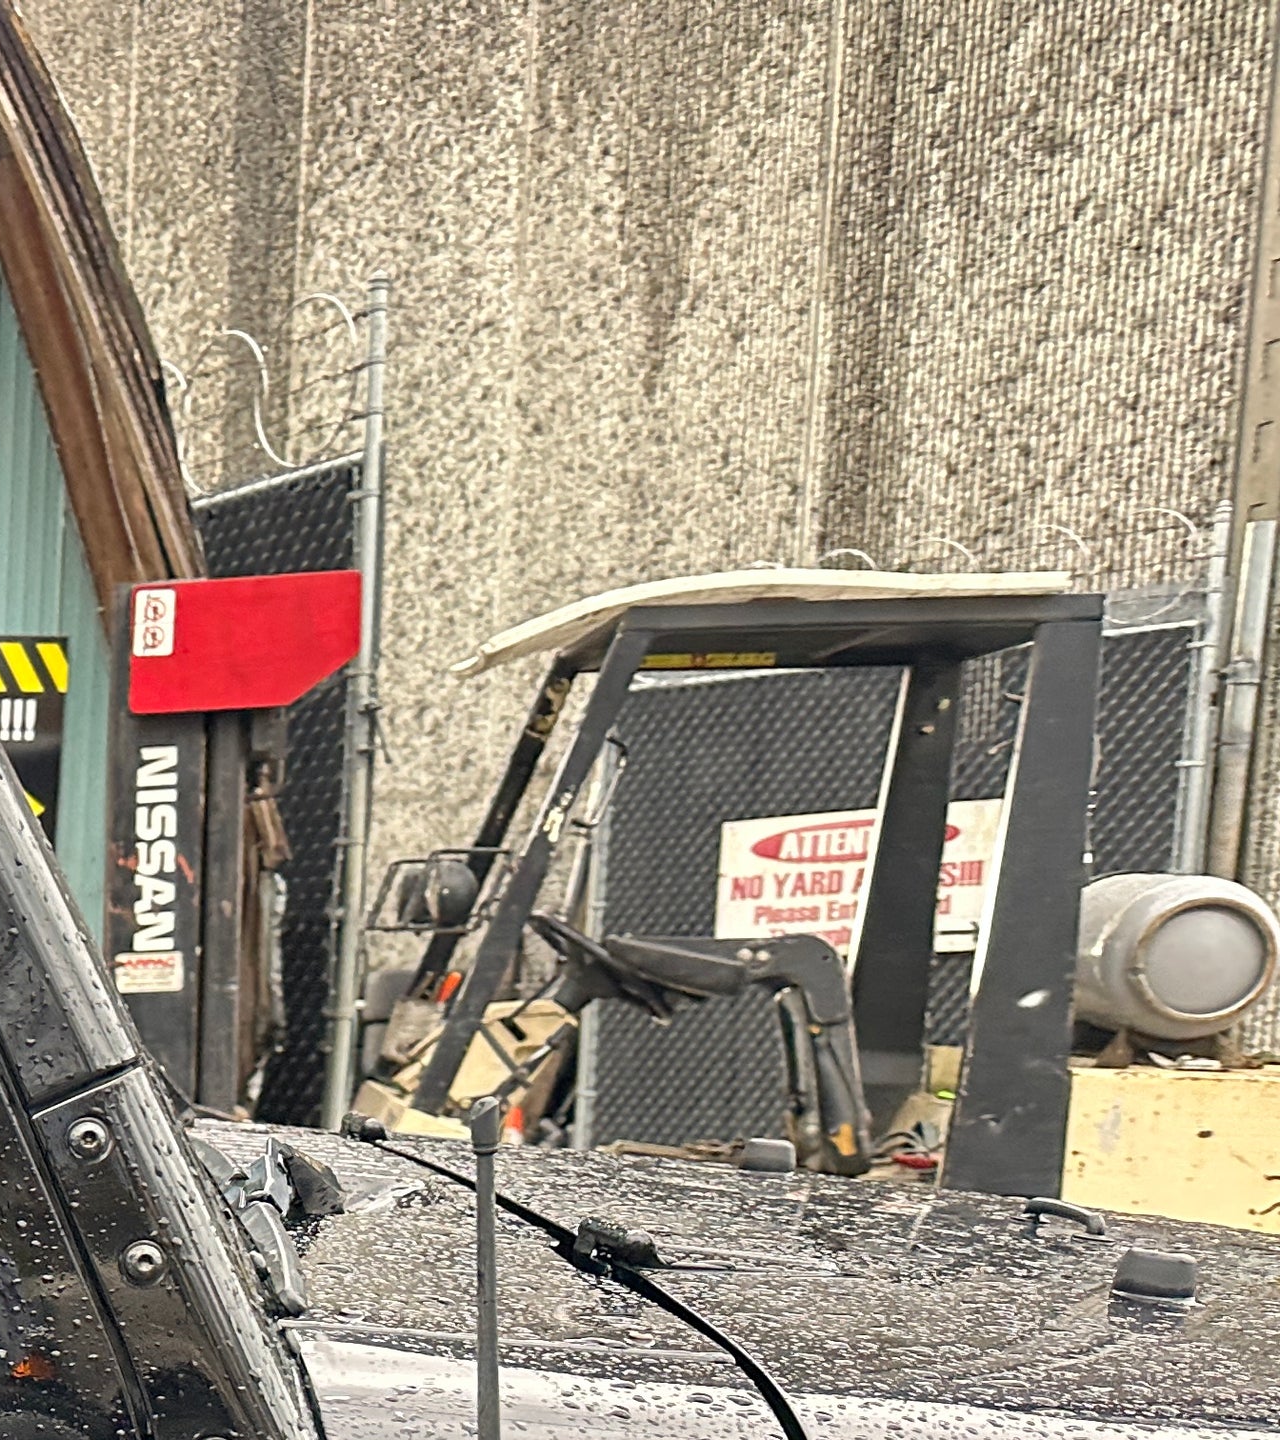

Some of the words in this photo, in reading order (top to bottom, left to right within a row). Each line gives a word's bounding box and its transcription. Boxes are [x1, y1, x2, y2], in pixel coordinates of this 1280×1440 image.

[133, 745, 178, 951] NISSAN
[778, 827, 868, 860] ATTEN
[730, 875, 763, 900] NO
[774, 869, 843, 898] YARD
[753, 905, 820, 925] Please
[827, 900, 858, 921] Ent
